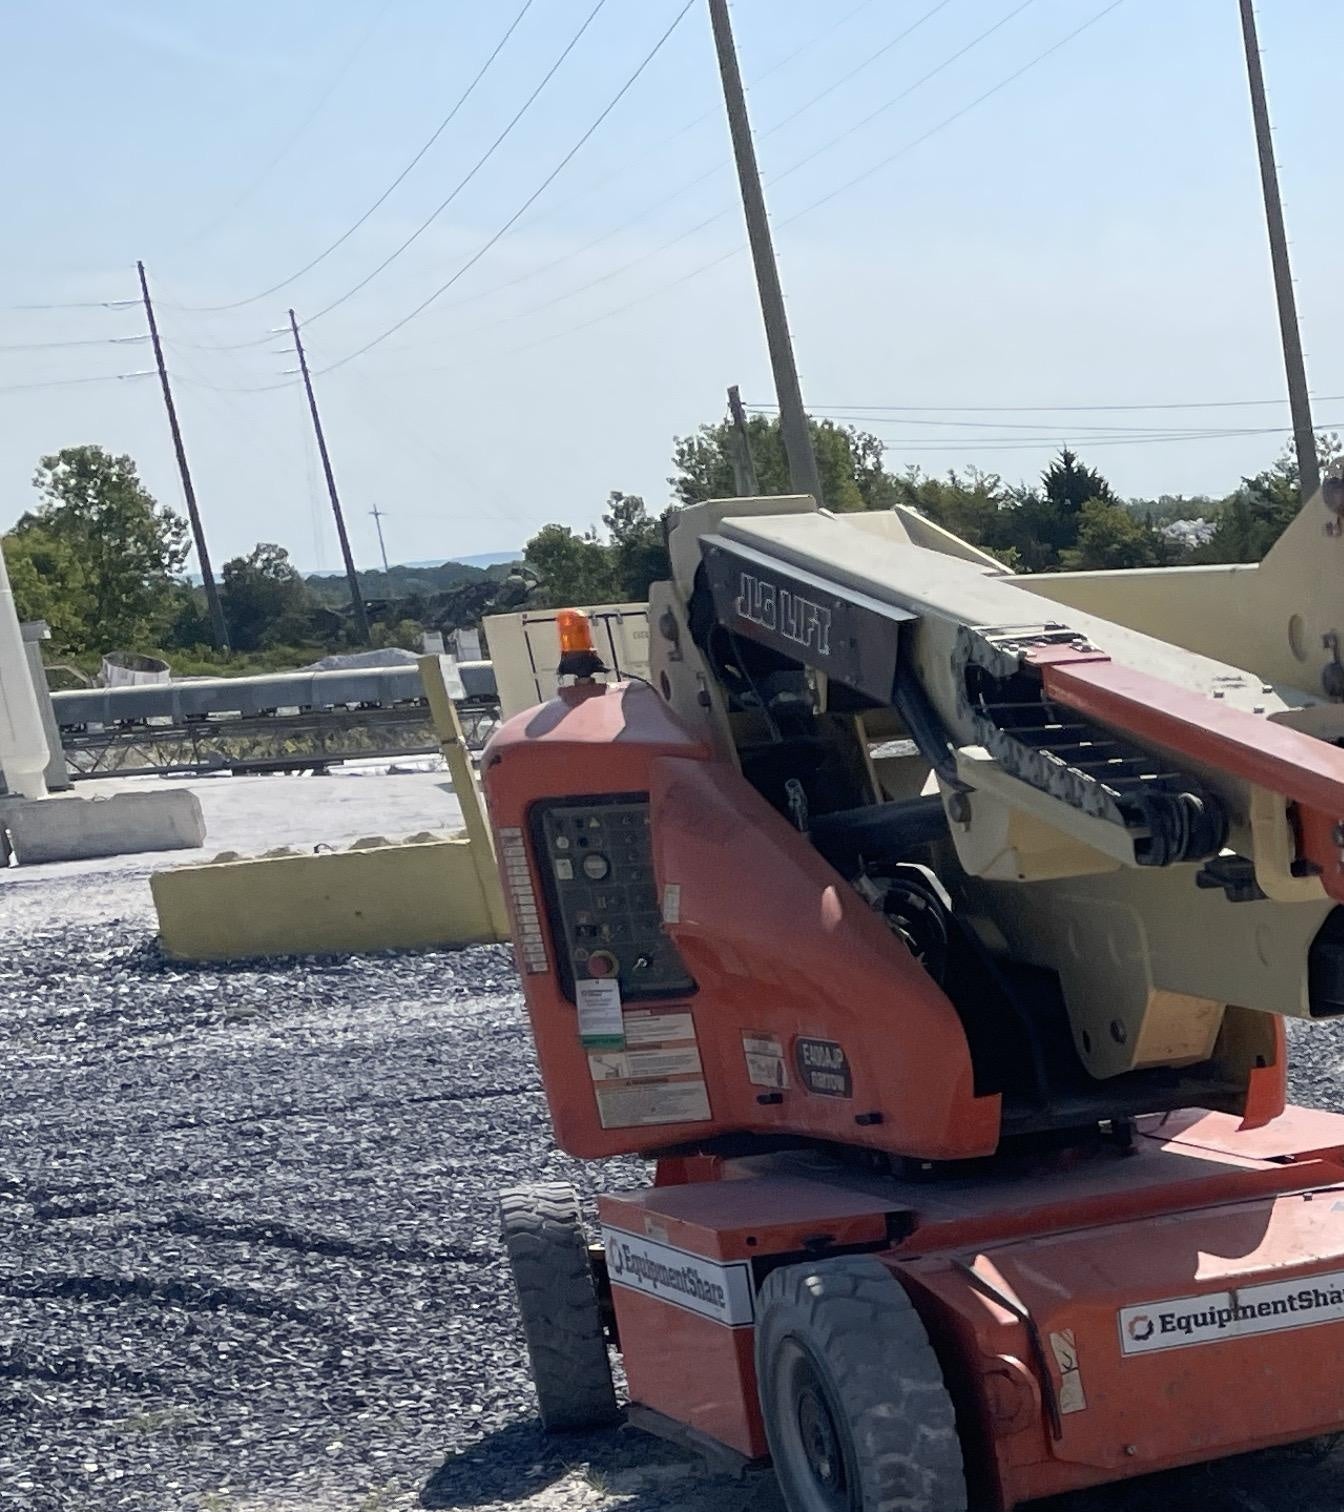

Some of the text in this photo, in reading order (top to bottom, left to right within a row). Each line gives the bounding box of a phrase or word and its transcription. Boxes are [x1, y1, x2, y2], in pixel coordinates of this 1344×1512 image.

[736, 572, 831, 655] JLG LIFT
[622, 1243, 726, 1309] EquipmentShare
